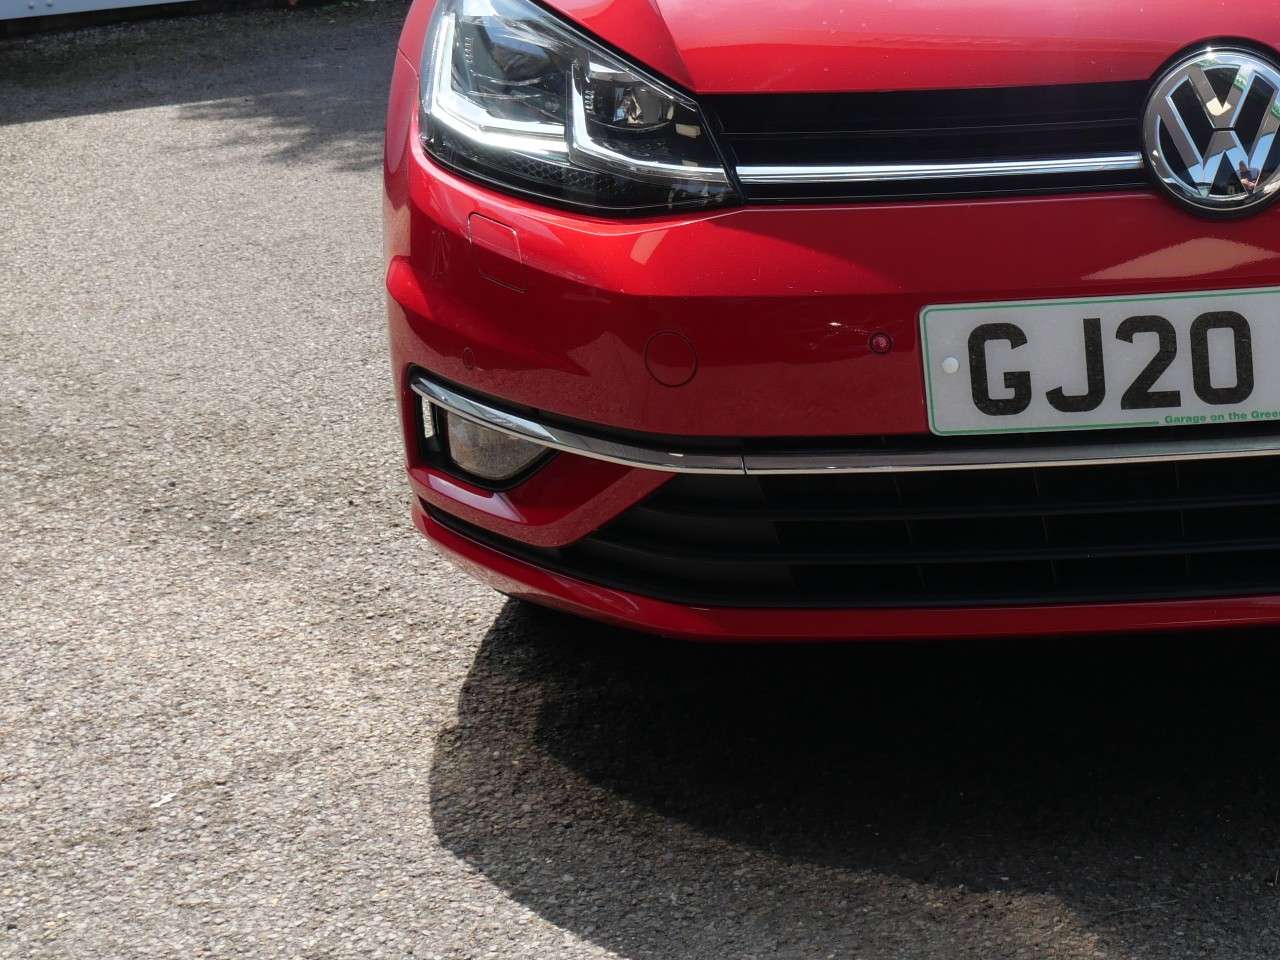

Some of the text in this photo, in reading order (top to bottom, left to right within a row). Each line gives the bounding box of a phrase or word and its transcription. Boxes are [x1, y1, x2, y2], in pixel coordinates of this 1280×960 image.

[968, 311, 1255, 416] GJ20
[1164, 415, 1207, 425] Garage
[1210, 414, 1225, 422] on
[1228, 411, 1248, 420] the
